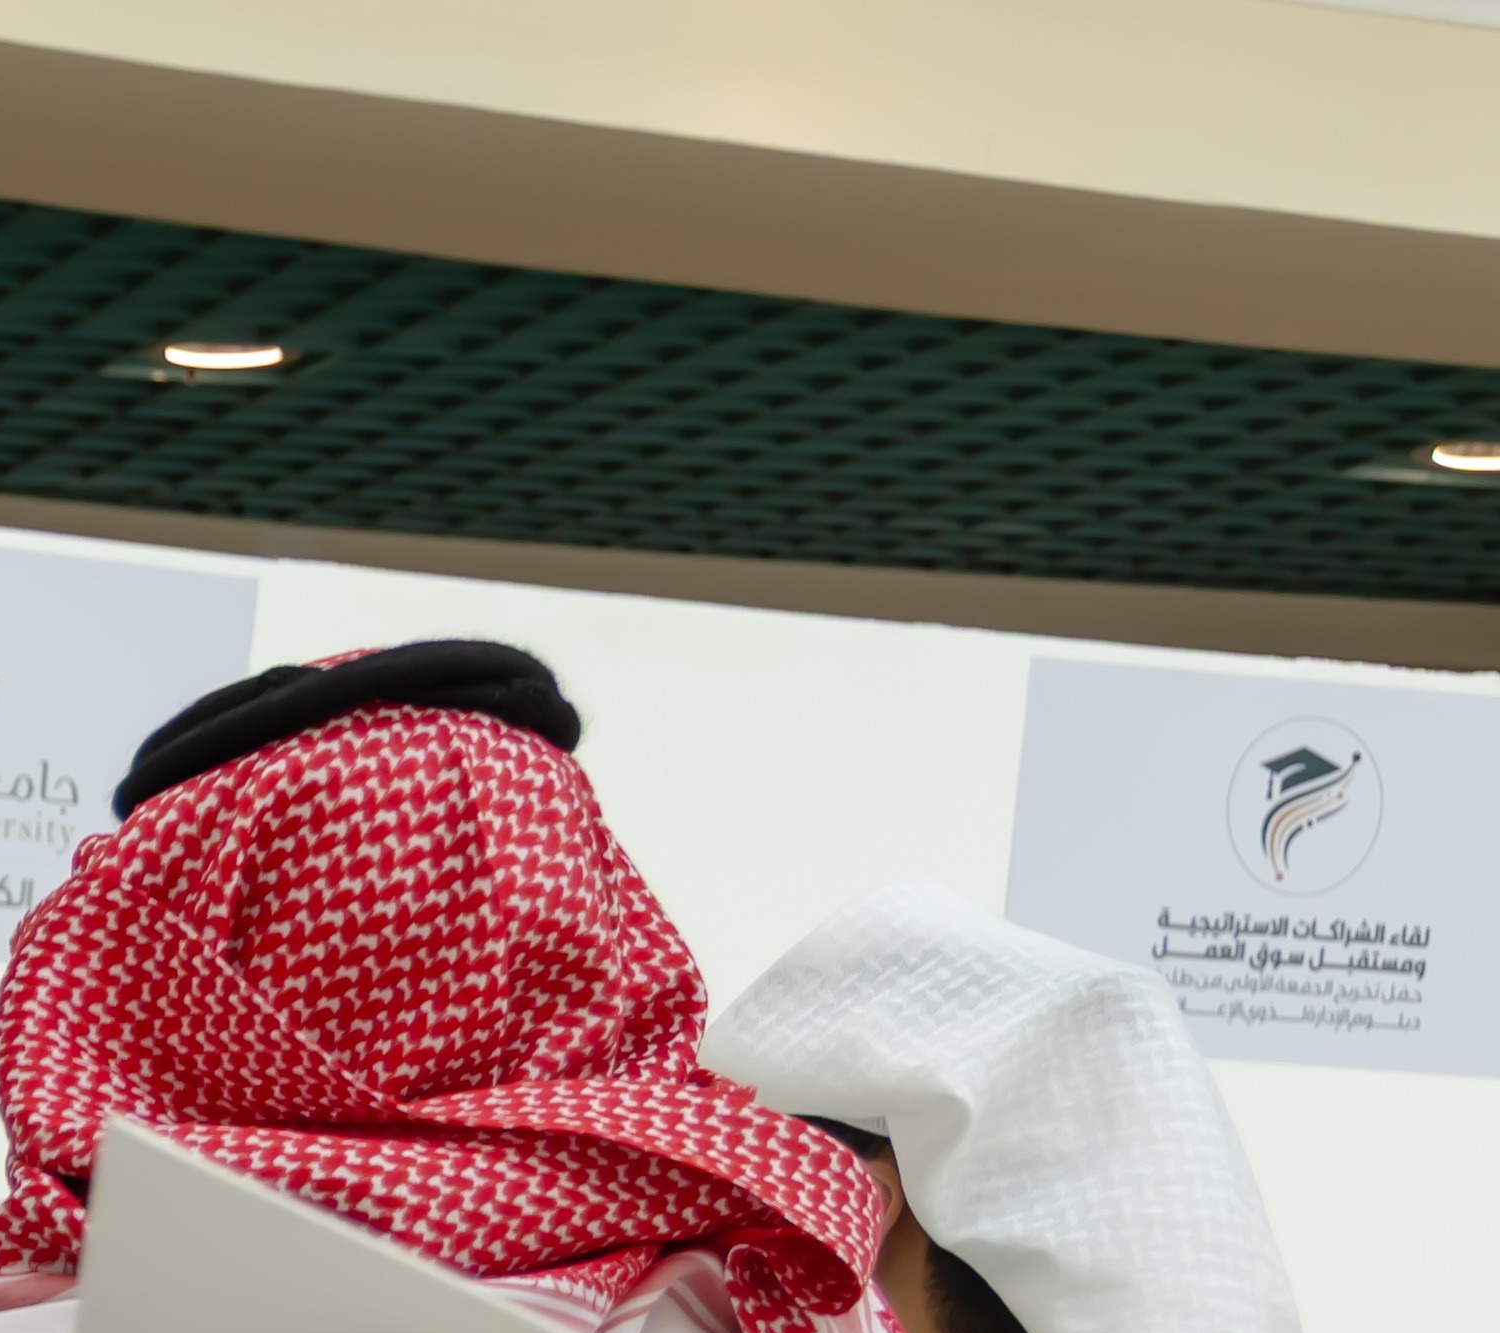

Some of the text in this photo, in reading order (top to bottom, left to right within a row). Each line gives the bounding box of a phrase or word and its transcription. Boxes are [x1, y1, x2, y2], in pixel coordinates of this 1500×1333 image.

[1151, 934, 1246, 961] العمل
[1388, 925, 1431, 948] لقاء
[1249, 942, 1305, 971] سوق
